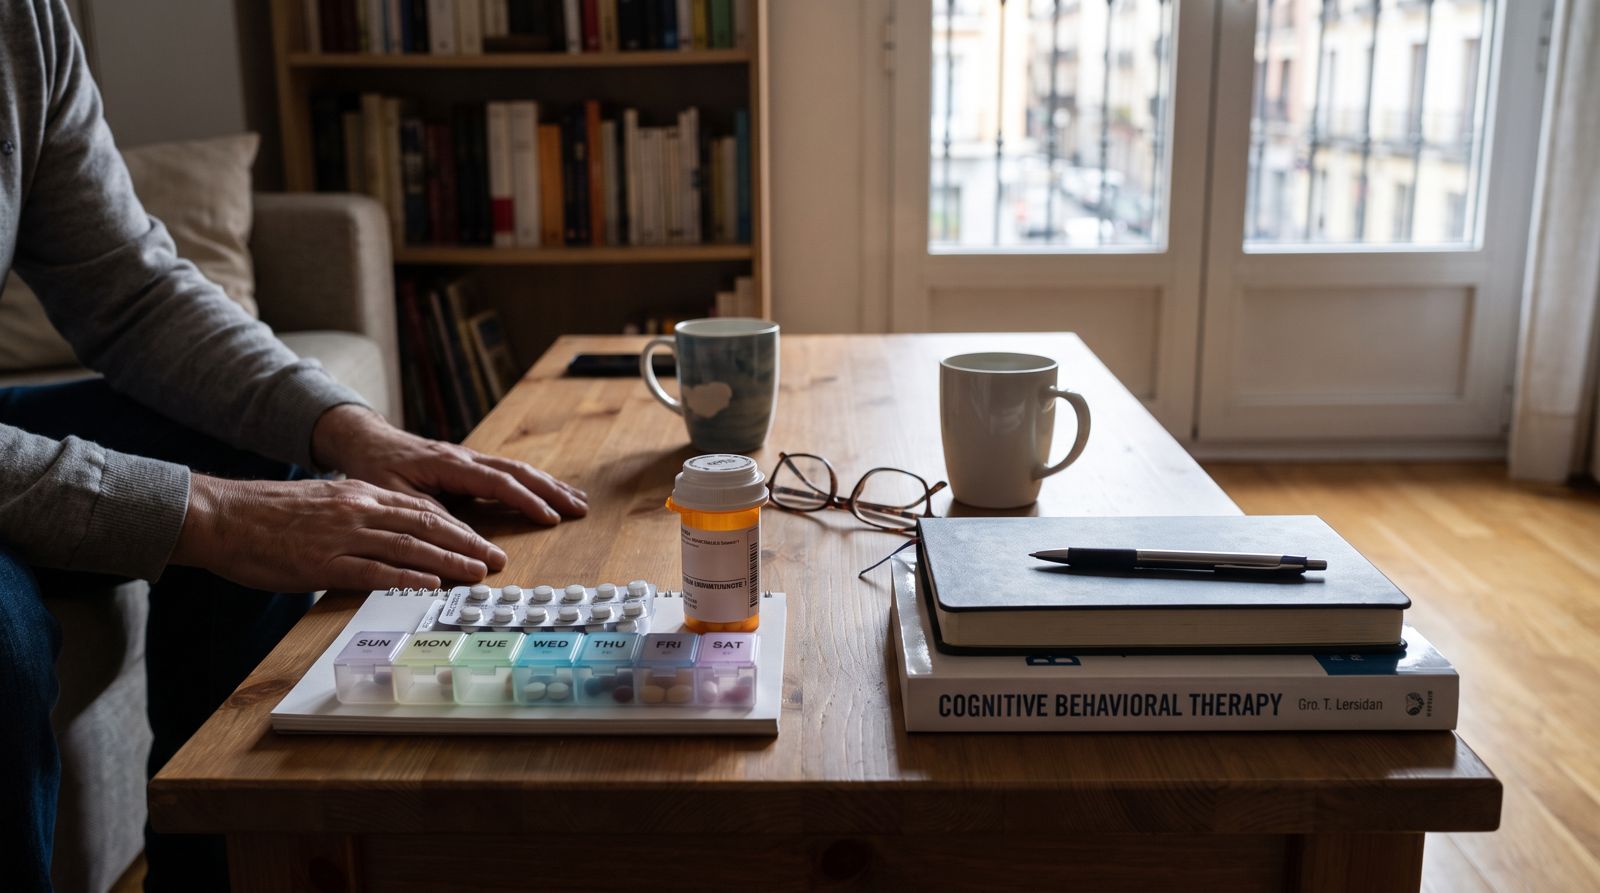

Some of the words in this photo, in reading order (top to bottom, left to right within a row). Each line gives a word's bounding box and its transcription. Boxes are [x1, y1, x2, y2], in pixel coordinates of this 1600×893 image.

[356, 639, 392, 648] SUN
[413, 639, 453, 648] MON
[477, 640, 509, 648] TUE
[533, 640, 569, 648] WED
[594, 640, 626, 649] THU
[656, 640, 681, 649] FRI
[712, 640, 744, 649] SAT
[938, 694, 1048, 717] COGNITIVE
[1055, 693, 1182, 717] BEHAVIORAL
[1189, 693, 1283, 716] THERAPY
[1323, 698, 1332, 711] T.
[1336, 698, 1383, 711] Lersidan
